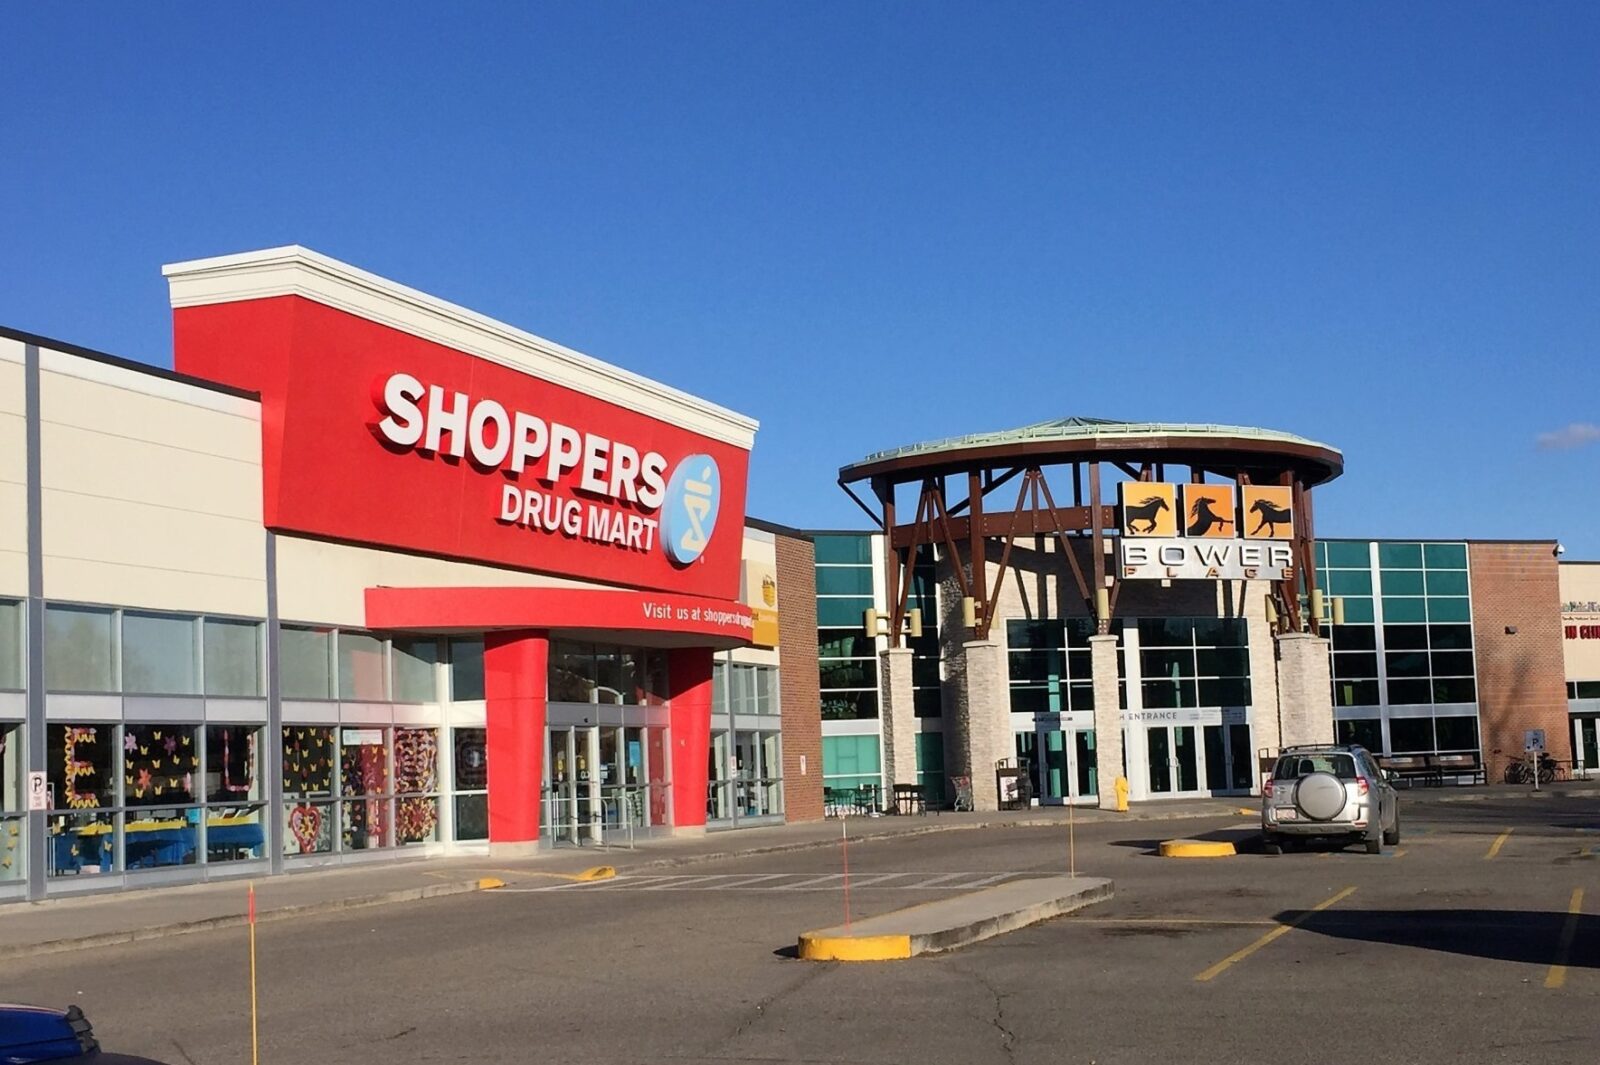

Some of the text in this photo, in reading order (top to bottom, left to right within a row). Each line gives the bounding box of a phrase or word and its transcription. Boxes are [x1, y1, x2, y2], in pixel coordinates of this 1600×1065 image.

[378, 372, 668, 509] SHOPPERS
[501, 484, 659, 551] DRUG MART
[1123, 544, 1294, 568] BOWER
[1124, 566, 1294, 579] PLACE
[643, 602, 672, 619] Visit
[676, 607, 689, 620] us
[691, 607, 701, 621] at
[1128, 711, 1178, 721] ENTRANCE
